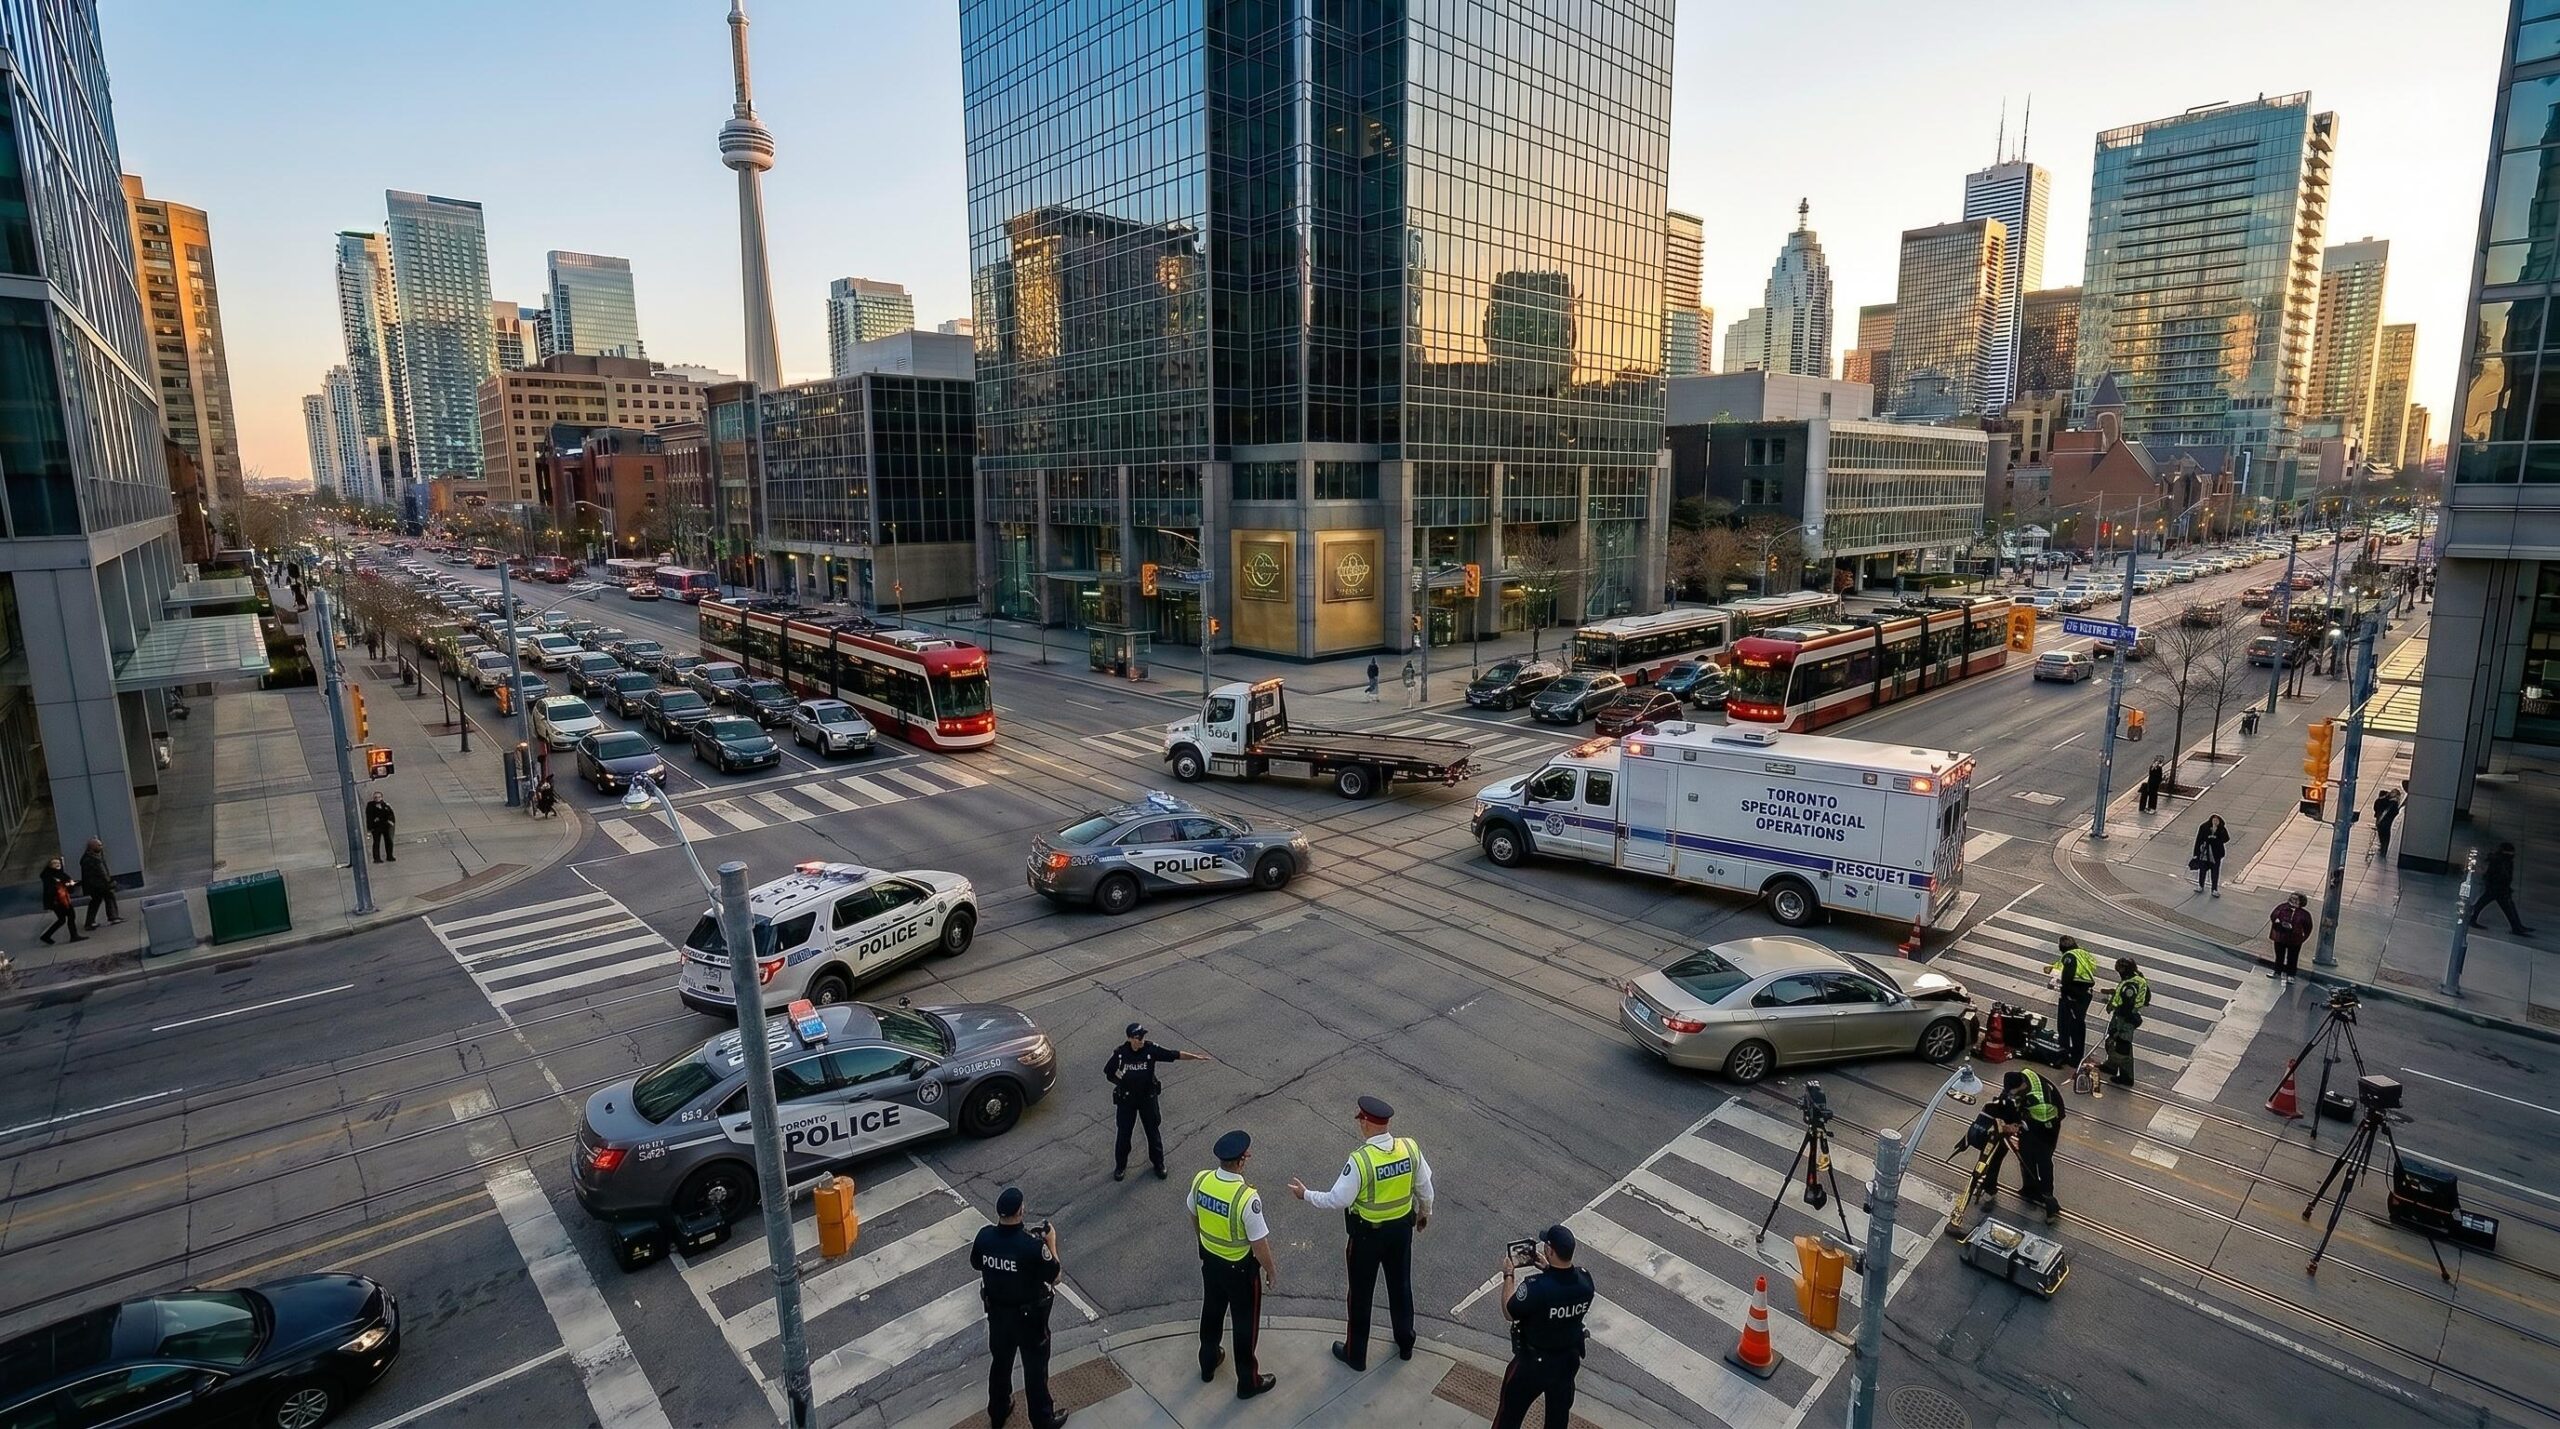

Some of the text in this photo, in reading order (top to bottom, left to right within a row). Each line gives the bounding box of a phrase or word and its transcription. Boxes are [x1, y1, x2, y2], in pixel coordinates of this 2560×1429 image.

[1766, 787, 1838, 809] TORONTO
[1741, 800, 1801, 820] SPECIAL
[1755, 817, 1846, 842] OPERATIONS
[1154, 855, 1224, 874] POLICE
[859, 921, 918, 961] POLICE
[780, 1114, 828, 1133] TORONTO
[785, 1105, 901, 1153] POLICE
[1376, 1159, 1410, 1180] POLICE
[1197, 1191, 1228, 1217] POLICE
[982, 1254, 1018, 1272] POLICE
[1549, 1301, 1589, 1319] POLICE
